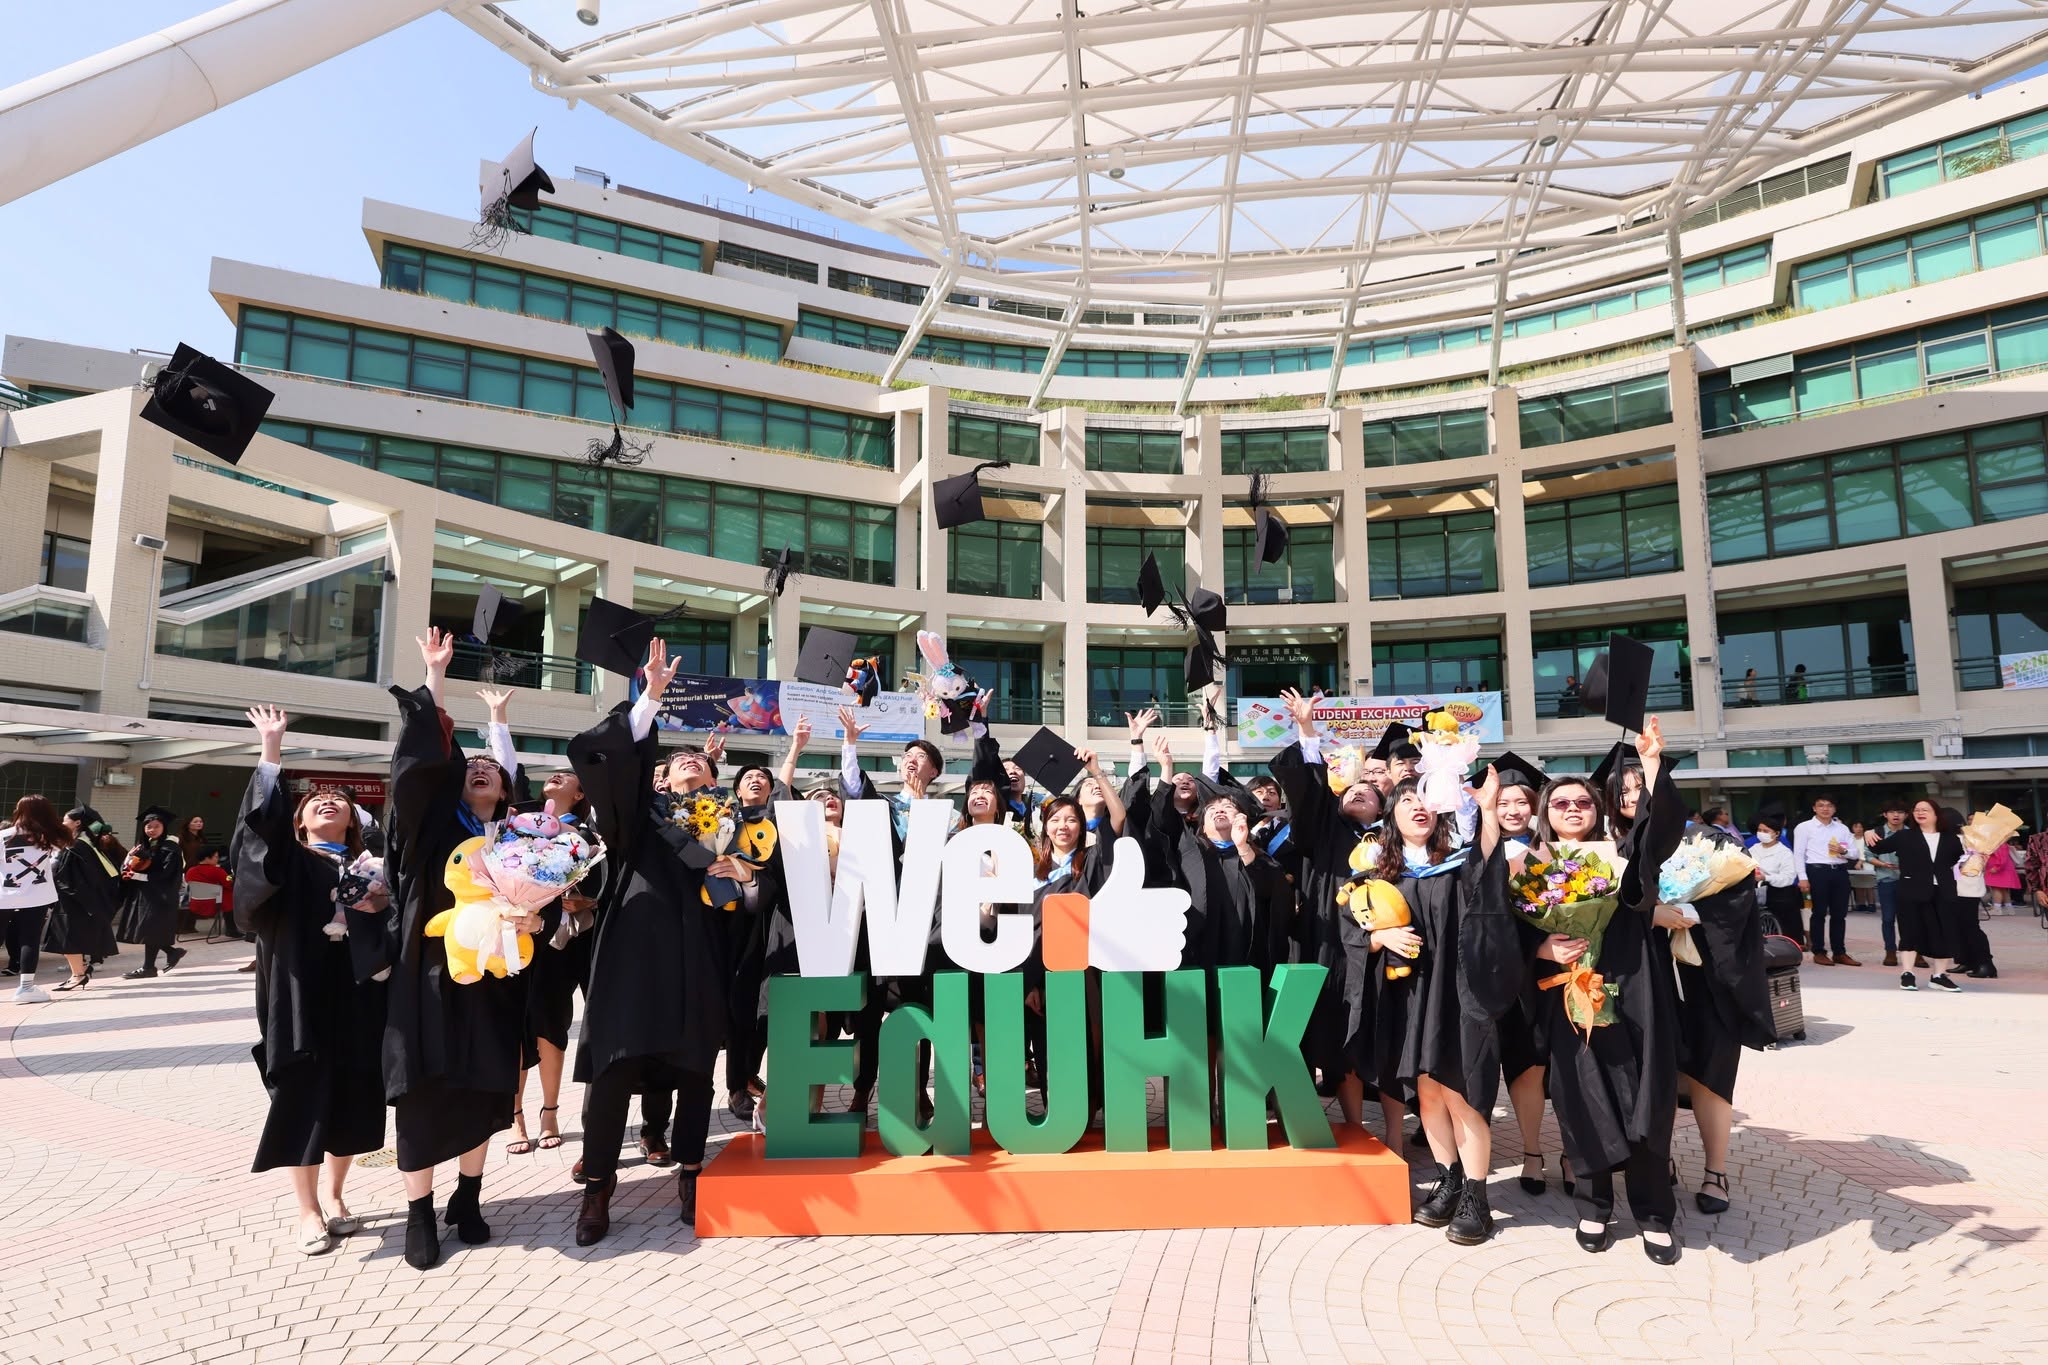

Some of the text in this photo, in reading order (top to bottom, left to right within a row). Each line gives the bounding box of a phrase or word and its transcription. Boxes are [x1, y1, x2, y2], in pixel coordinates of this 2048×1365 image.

[1289, 655, 1309, 663] Library
[1312, 710, 1357, 720] TUDENT
[774, 799, 1034, 977] We
[765, 963, 1338, 1159] EdUHK
